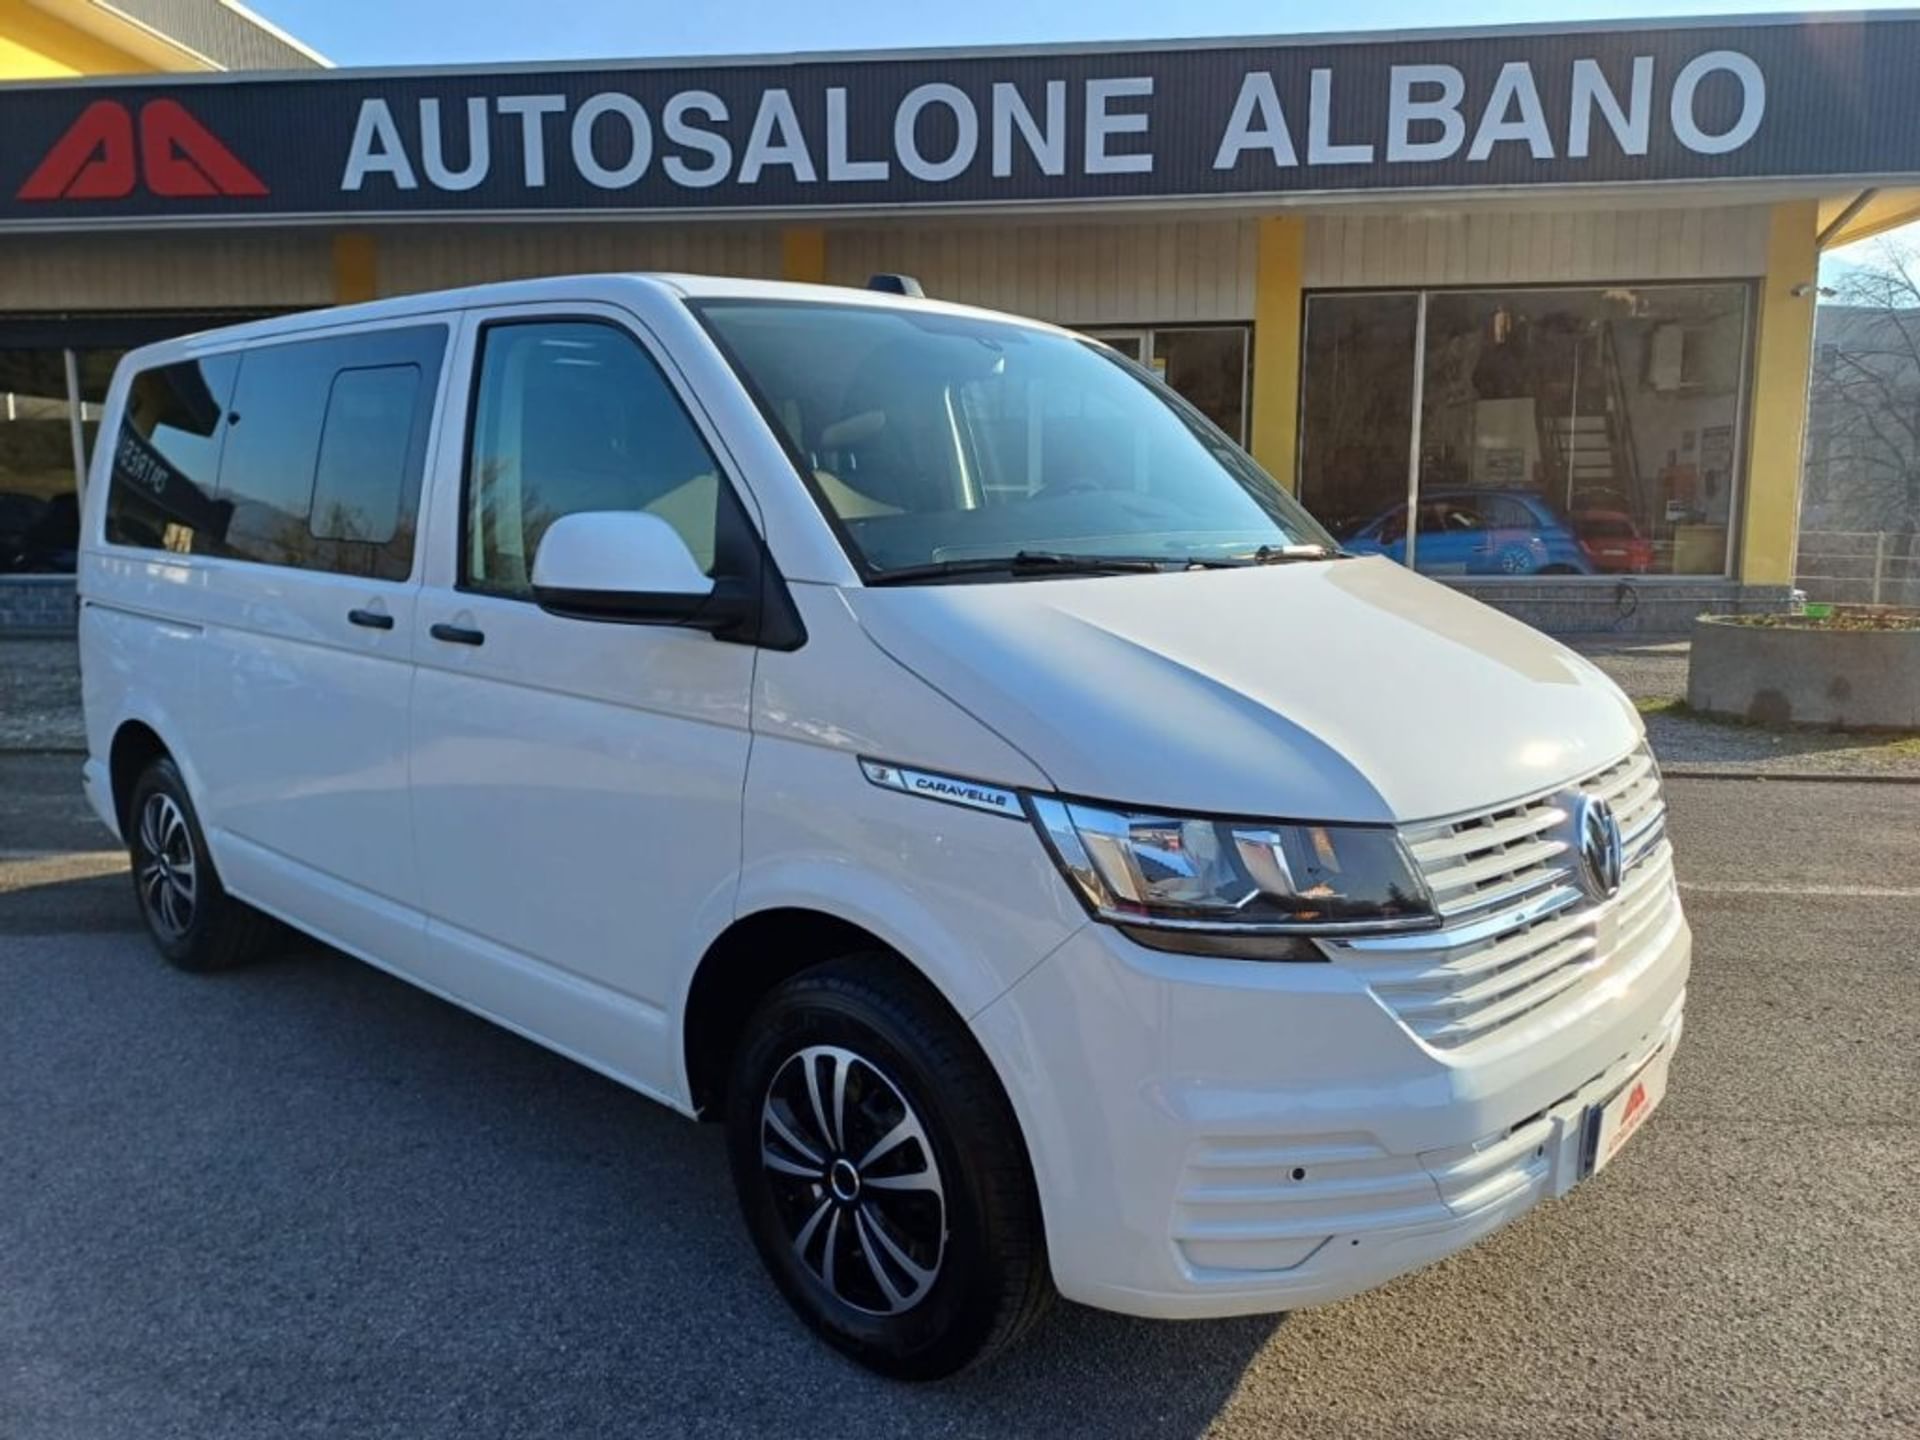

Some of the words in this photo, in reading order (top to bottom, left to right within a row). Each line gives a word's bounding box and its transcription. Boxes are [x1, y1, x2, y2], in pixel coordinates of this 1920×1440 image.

[341, 76, 1155, 192] AUTOSALONE
[1212, 50, 1767, 170] ALBANO
[915, 777, 1007, 807] CARAVELLE
